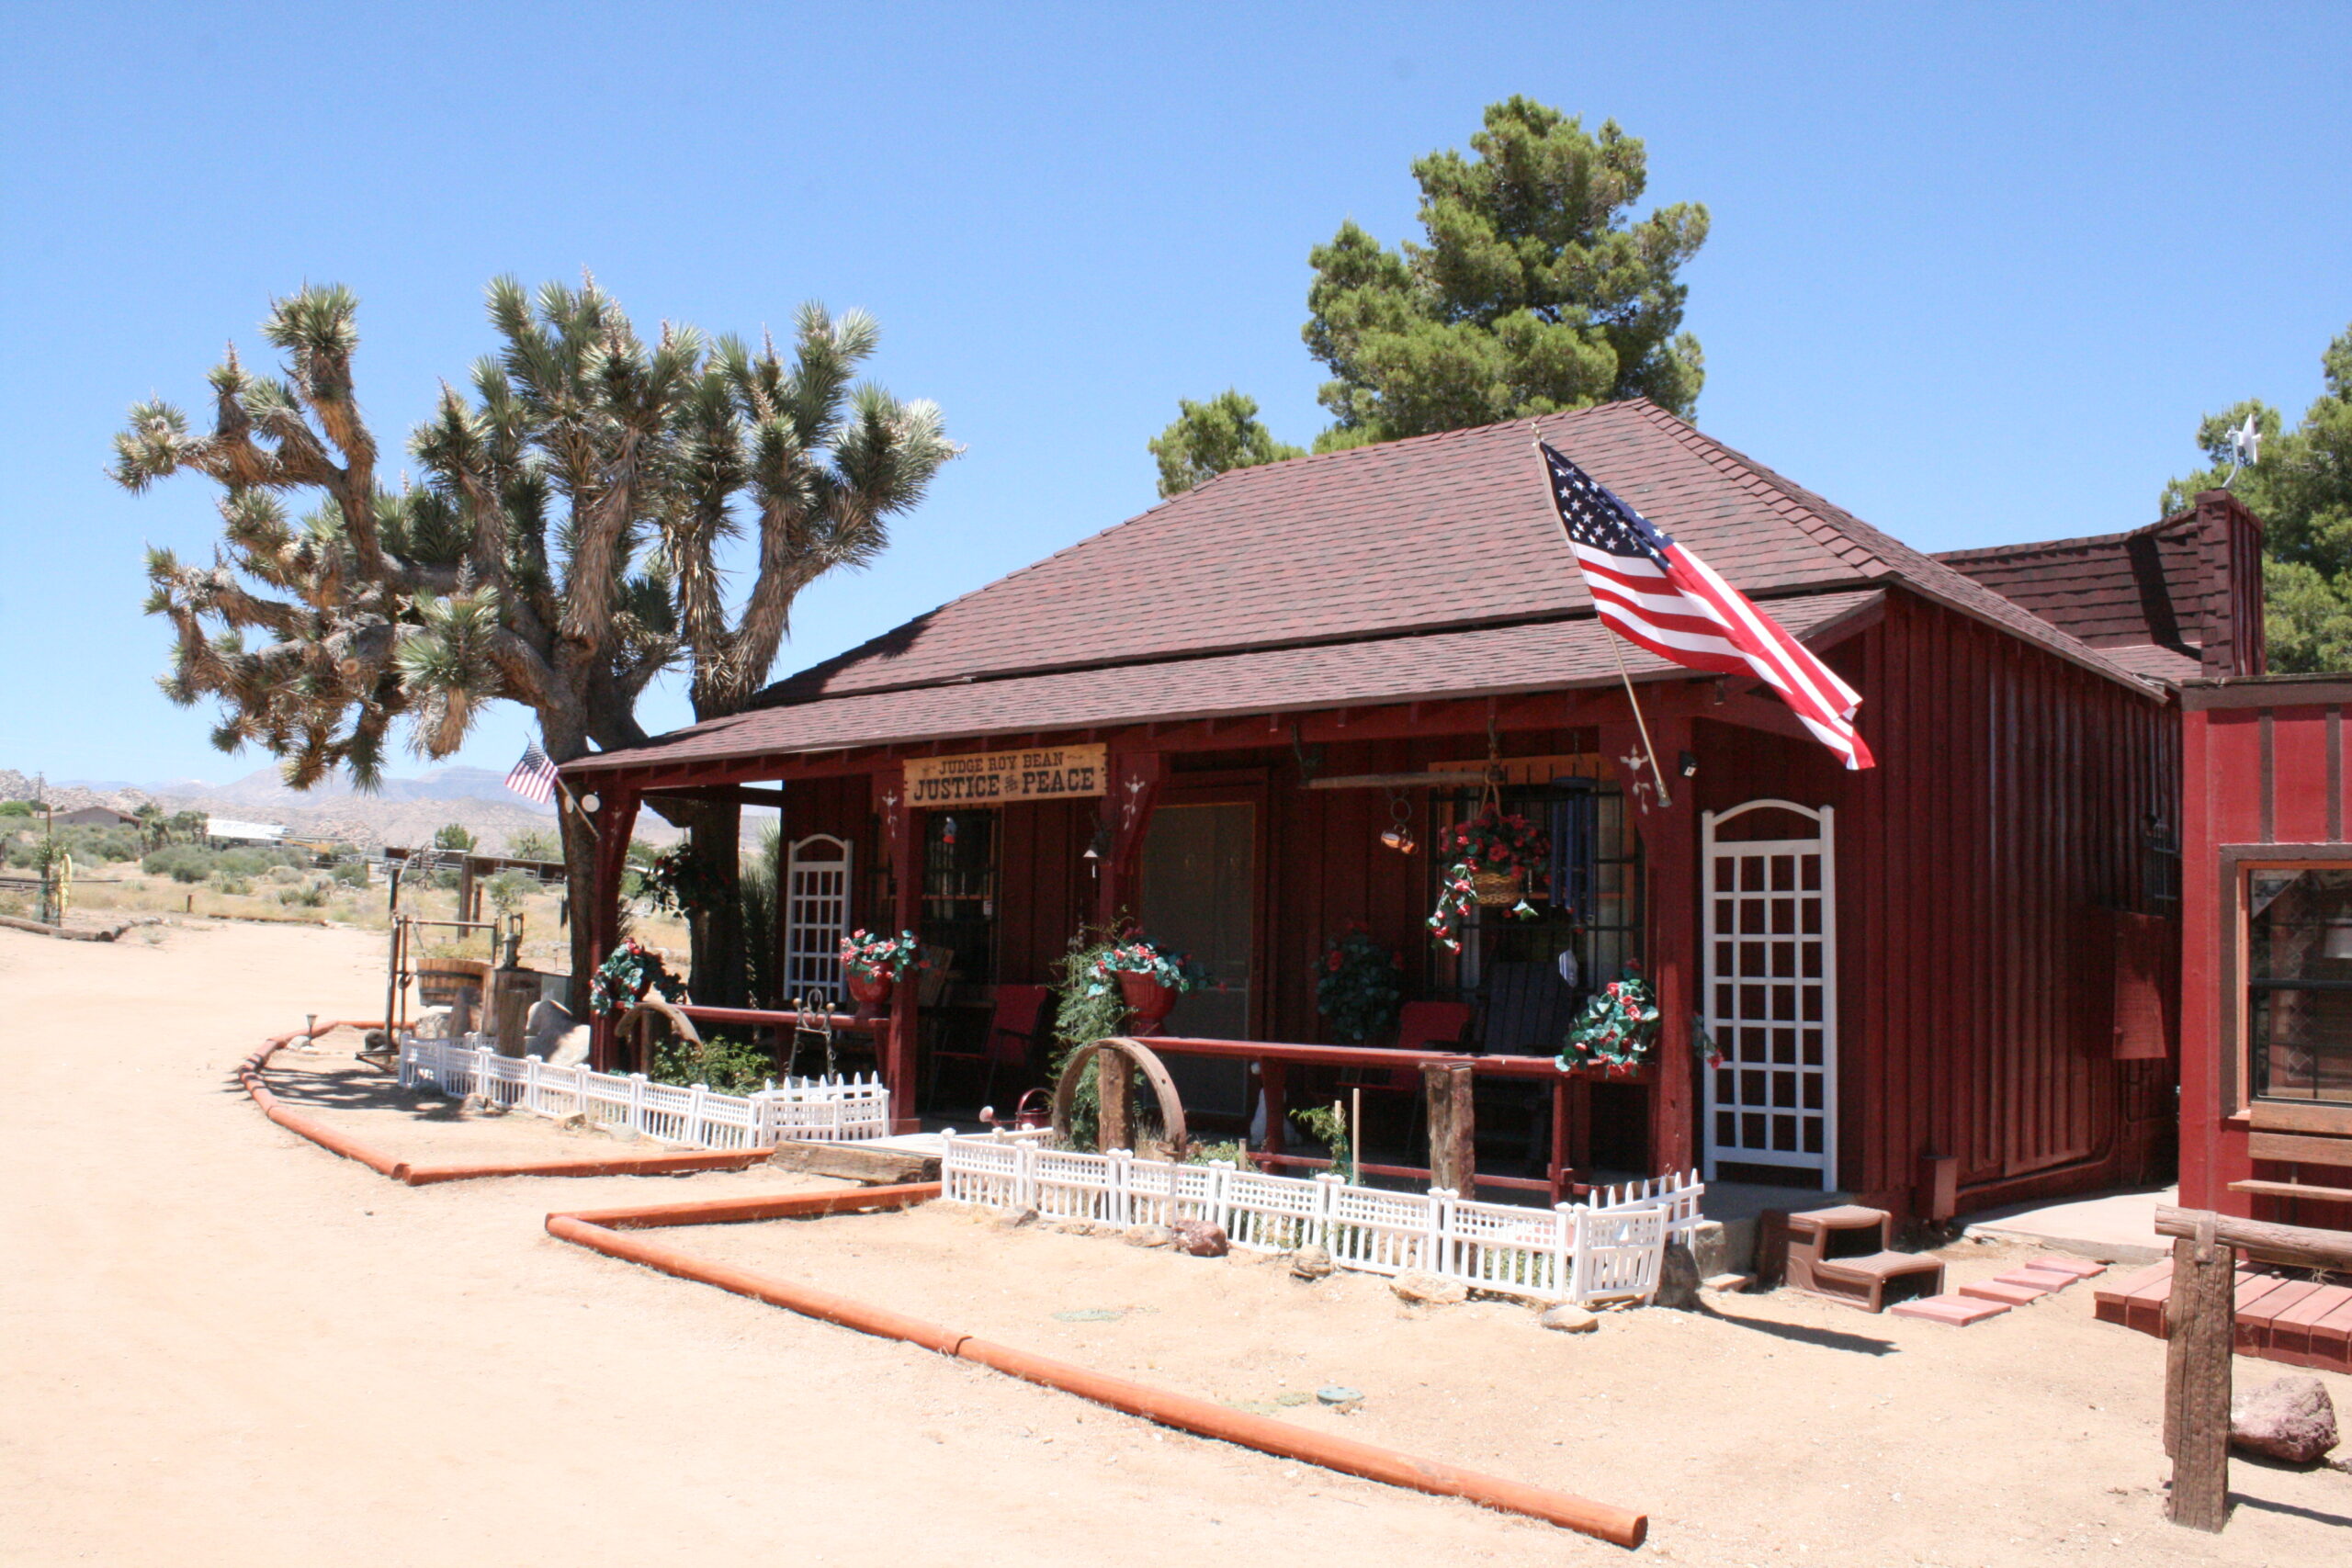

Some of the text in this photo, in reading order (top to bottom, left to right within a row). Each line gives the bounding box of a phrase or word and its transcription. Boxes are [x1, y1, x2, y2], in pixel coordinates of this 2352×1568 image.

[939, 751, 1064, 775] JUDGE ROY BEAN
[914, 774, 1001, 801] JUSTICE
[1022, 767, 1095, 795] PEACE
